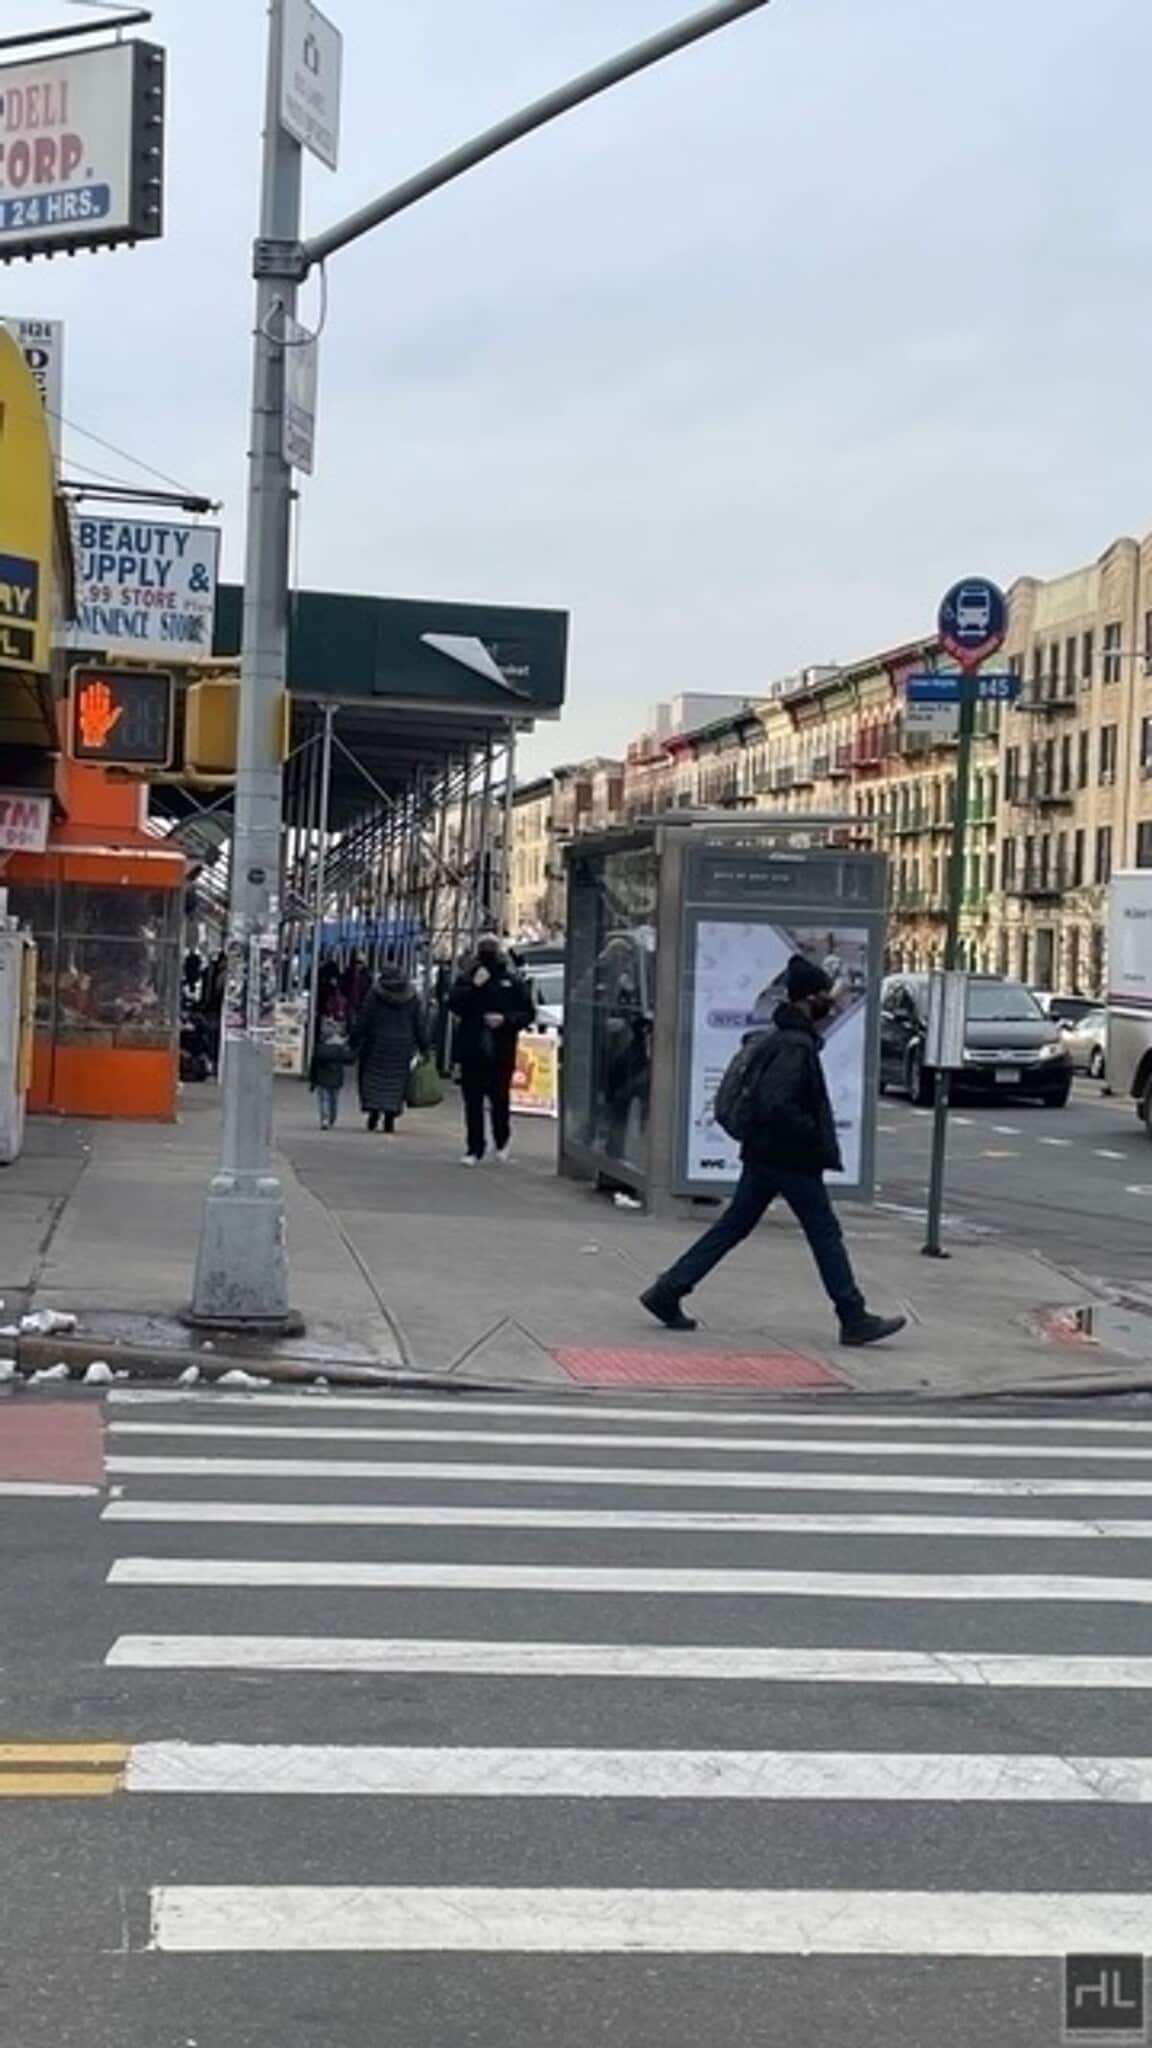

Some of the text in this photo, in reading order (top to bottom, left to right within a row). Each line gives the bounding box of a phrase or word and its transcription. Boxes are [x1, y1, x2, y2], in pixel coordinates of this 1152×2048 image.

[6, 80, 68, 131] DELI
[0, 132, 93, 188] ORP.
[12, 199, 39, 225] 24
[46, 189, 100, 222] HRS.
[79, 522, 190, 558] BEAUTY
[188, 562, 210, 593] &
[121, 586, 178, 610] STORE
